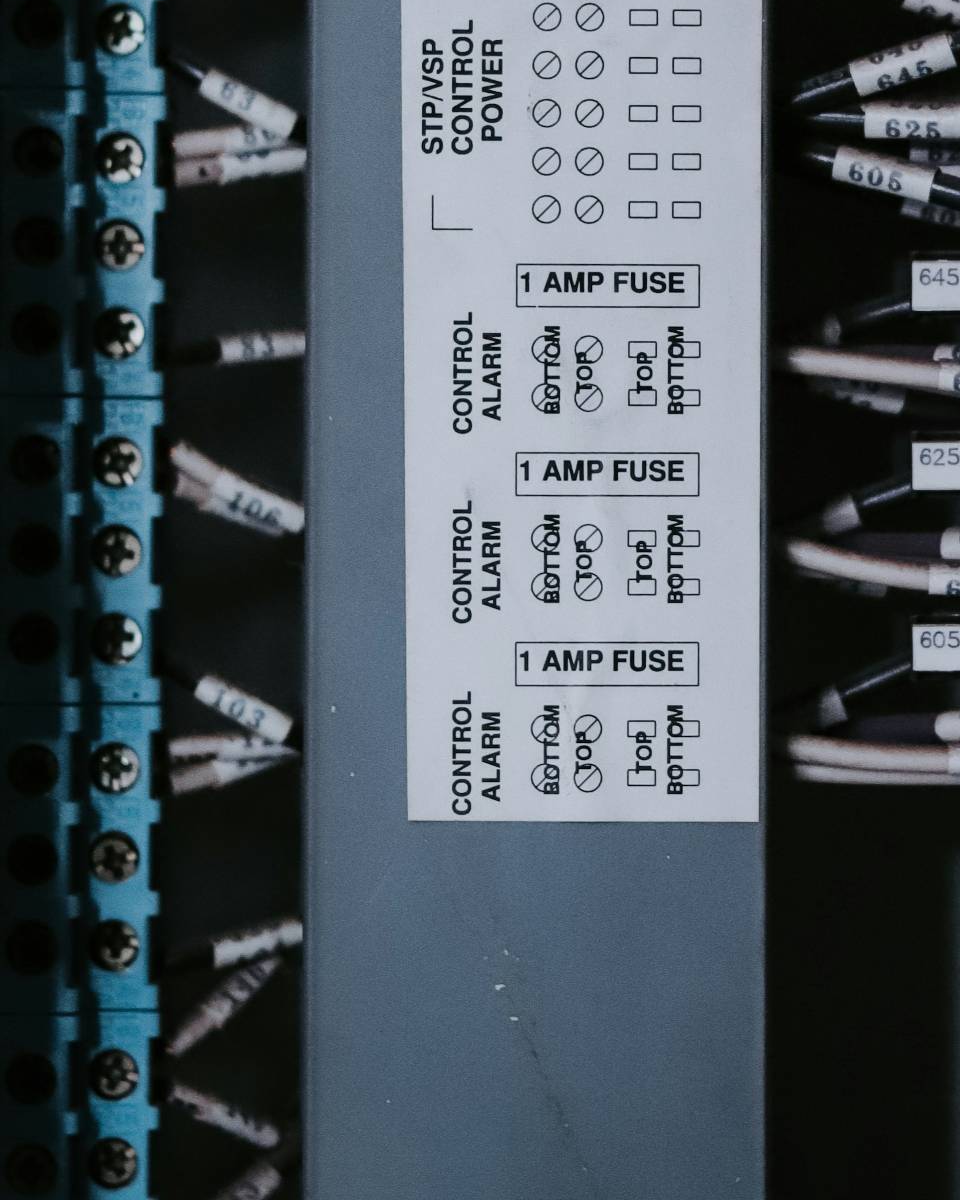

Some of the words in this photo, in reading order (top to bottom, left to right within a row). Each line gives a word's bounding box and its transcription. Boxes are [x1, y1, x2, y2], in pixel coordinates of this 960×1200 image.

[422, 39, 443, 154] STP/VSP
[451, 20, 473, 154] CONTROL
[481, 40, 503, 141] POWER
[885, 119, 941, 139] 625
[848, 161, 903, 192] 605
[521, 272, 529, 292] 1
[544, 272, 604, 292] AMP
[614, 272, 684, 293] FUSE
[920, 268, 959, 286] 645
[453, 312, 472, 434] CONTROL
[482, 333, 501, 421] ALARM
[544, 326, 560, 414] BOTTOM
[576, 351, 593, 395] TOP
[637, 351, 653, 394] TOP
[668, 326, 684, 414] BOTTOM
[520, 461, 529, 481] 1
[543, 460, 603, 481] AMP
[613, 460, 684, 482] FUSE
[920, 448, 960, 466] 625
[452, 500, 472, 623] CONTROL
[482, 522, 500, 610] ALARM
[544, 514, 560, 603] BOTTOM
[576, 541, 592, 583] TOP
[636, 540, 653, 583] TOP
[668, 514, 684, 603] BOTTOM
[520, 651, 528, 671] 1
[543, 650, 603, 671] AMP
[613, 650, 683, 672] FUSE
[920, 631, 960, 649] 605
[452, 691, 471, 815] CONTROL
[482, 712, 500, 801] ALARM
[544, 705, 560, 795] BOTTOM
[576, 732, 592, 774] TOP
[636, 731, 652, 774] TOP
[668, 705, 684, 795] BOTTOM
